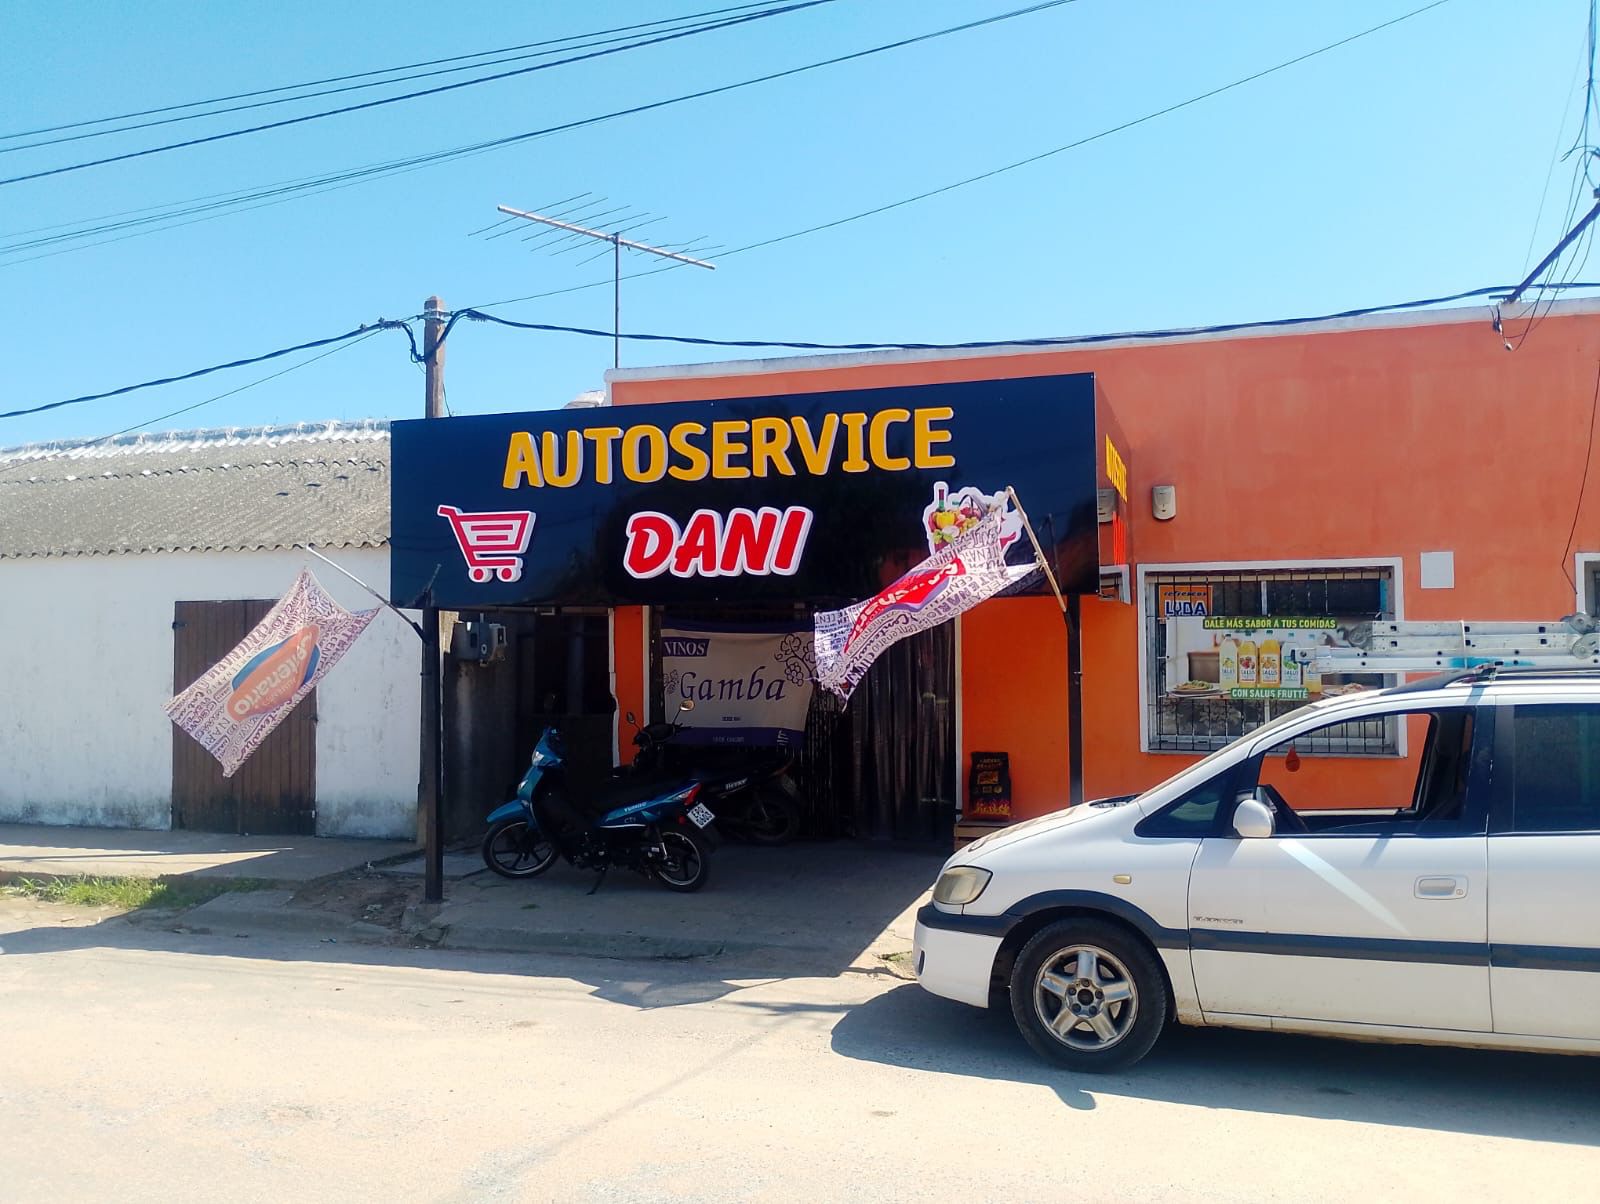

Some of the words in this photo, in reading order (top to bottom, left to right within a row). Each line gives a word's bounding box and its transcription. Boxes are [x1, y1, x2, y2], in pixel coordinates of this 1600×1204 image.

[503, 407, 956, 490] AUTOSERVICE
[623, 506, 813, 579] DANI
[1204, 620, 1225, 628] DALE
[1226, 618, 1243, 628] MÁS
[1245, 619, 1272, 628] SABOR
[1273, 619, 1280, 628] A
[1282, 619, 1297, 628] TUS
[1299, 619, 1336, 628] COMIDAS
[664, 641, 706, 656] VINOS
[680, 665, 786, 701] Gamba
[1232, 689, 1248, 697] CON
[1250, 689, 1275, 698] SALUS
[1277, 688, 1308, 699] FRUTTÉ
